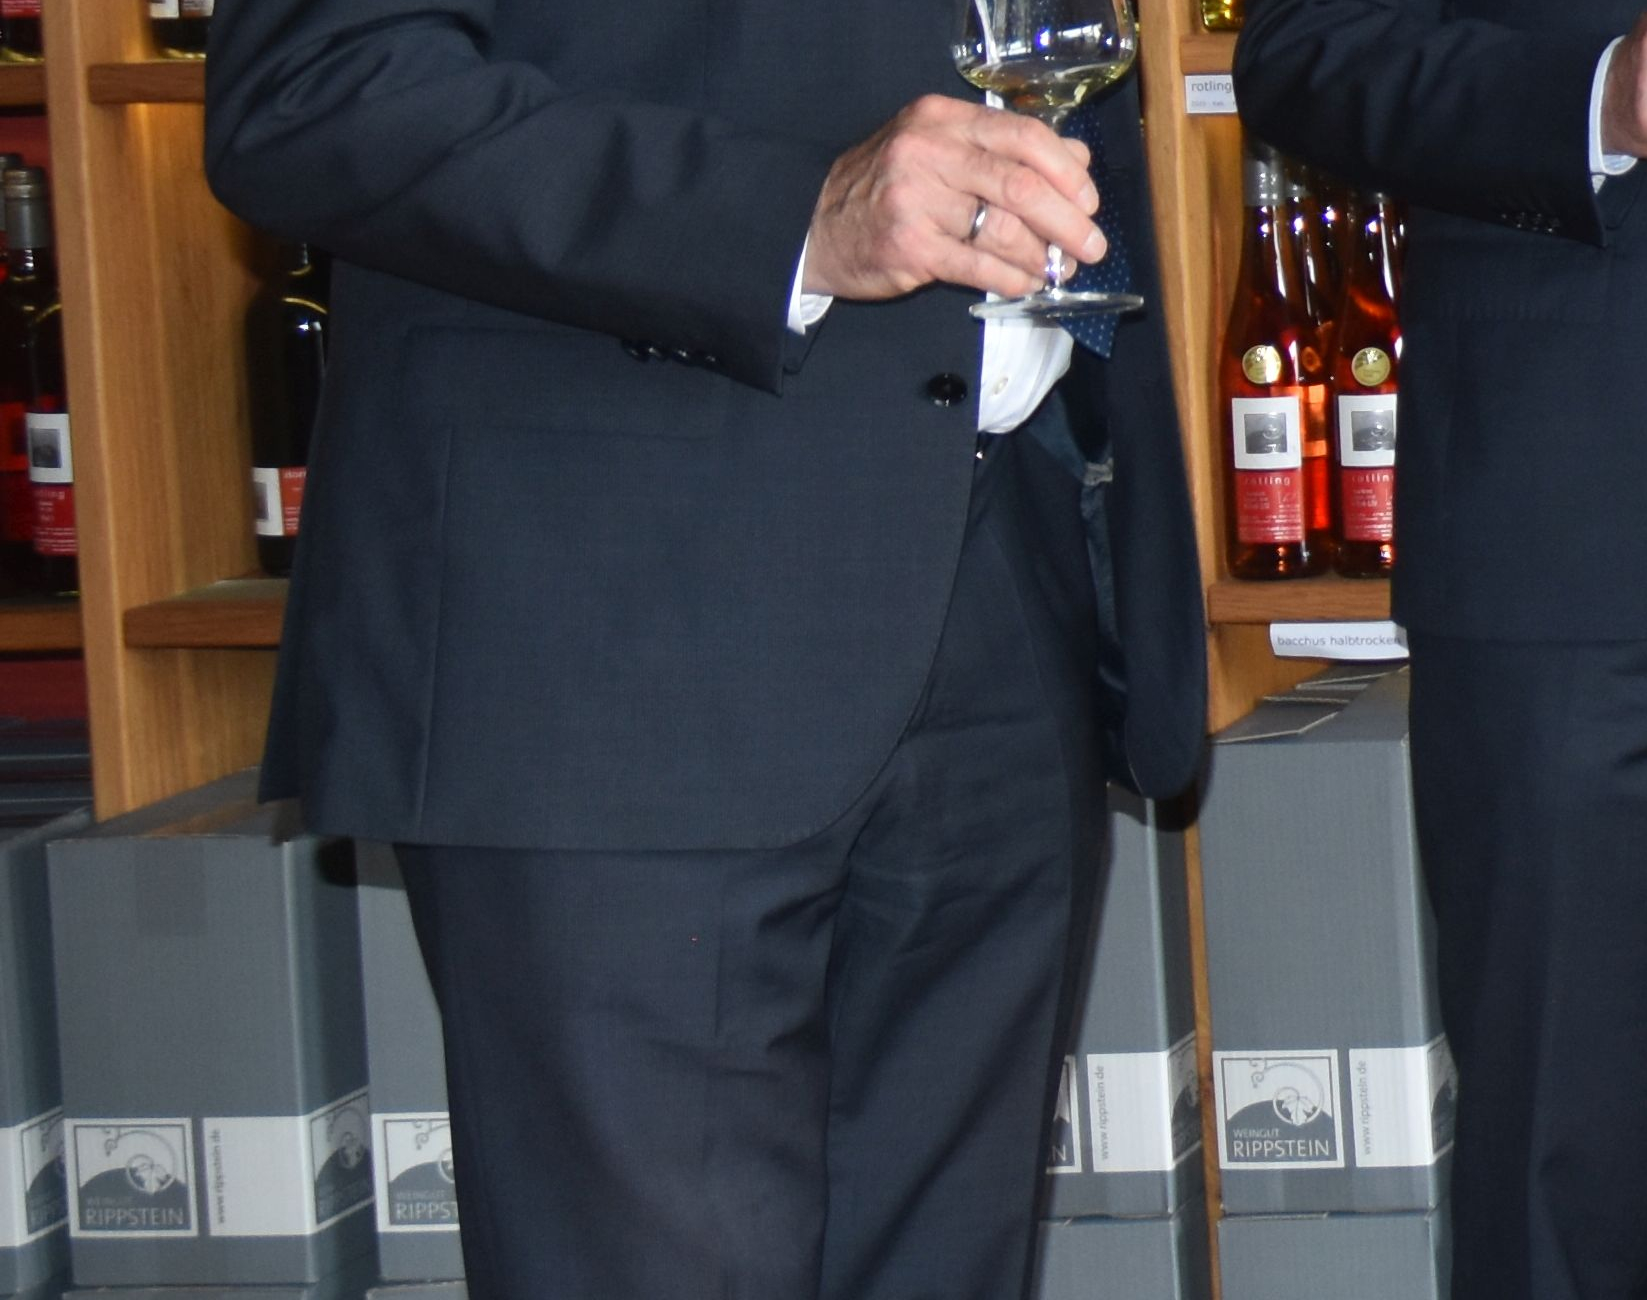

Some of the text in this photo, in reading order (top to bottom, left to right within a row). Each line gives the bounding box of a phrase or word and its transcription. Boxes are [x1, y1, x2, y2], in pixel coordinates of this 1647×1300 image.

[1191, 80, 1232, 94] rotling
[1277, 635, 1402, 646] bacchus halbtrocken
[1233, 1128, 1280, 1138] WEINGUT
[1233, 1139, 1330, 1158] RIPPSTEIN
[86, 1207, 184, 1226] RIPPSTEIN
